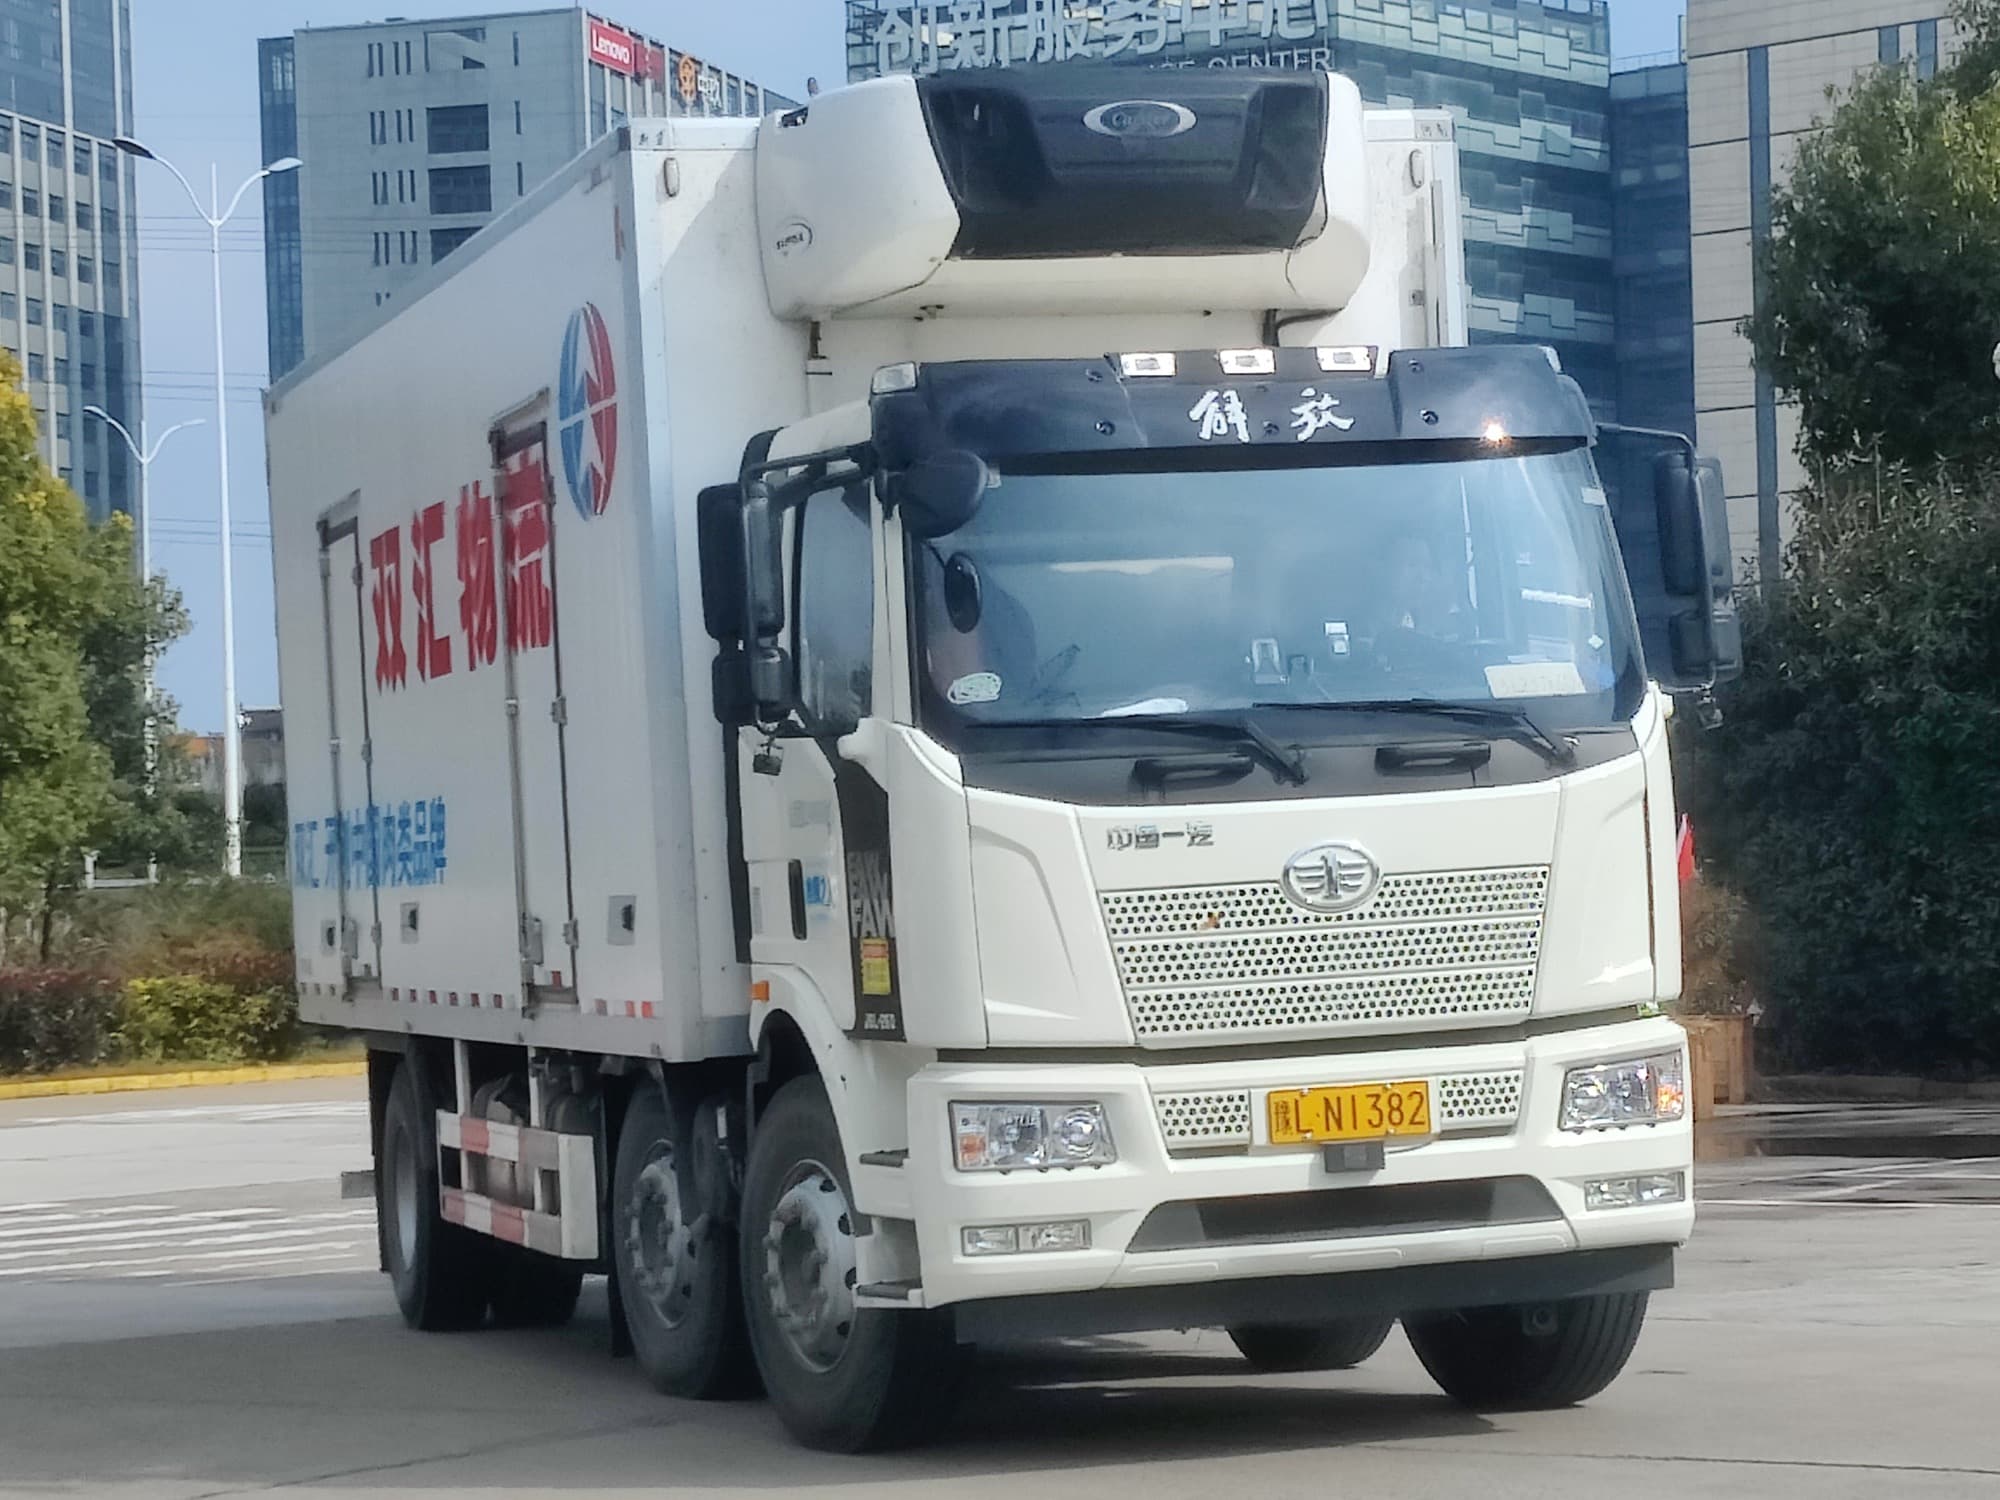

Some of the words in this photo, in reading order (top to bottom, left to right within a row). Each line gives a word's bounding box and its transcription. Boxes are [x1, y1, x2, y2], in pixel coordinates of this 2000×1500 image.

[592, 27, 630, 64] Lenovo
[873, 0, 1329, 77] 创新服务中心
[1189, 387, 1355, 442] 解放
[370, 450, 551, 695] 双汇物流
